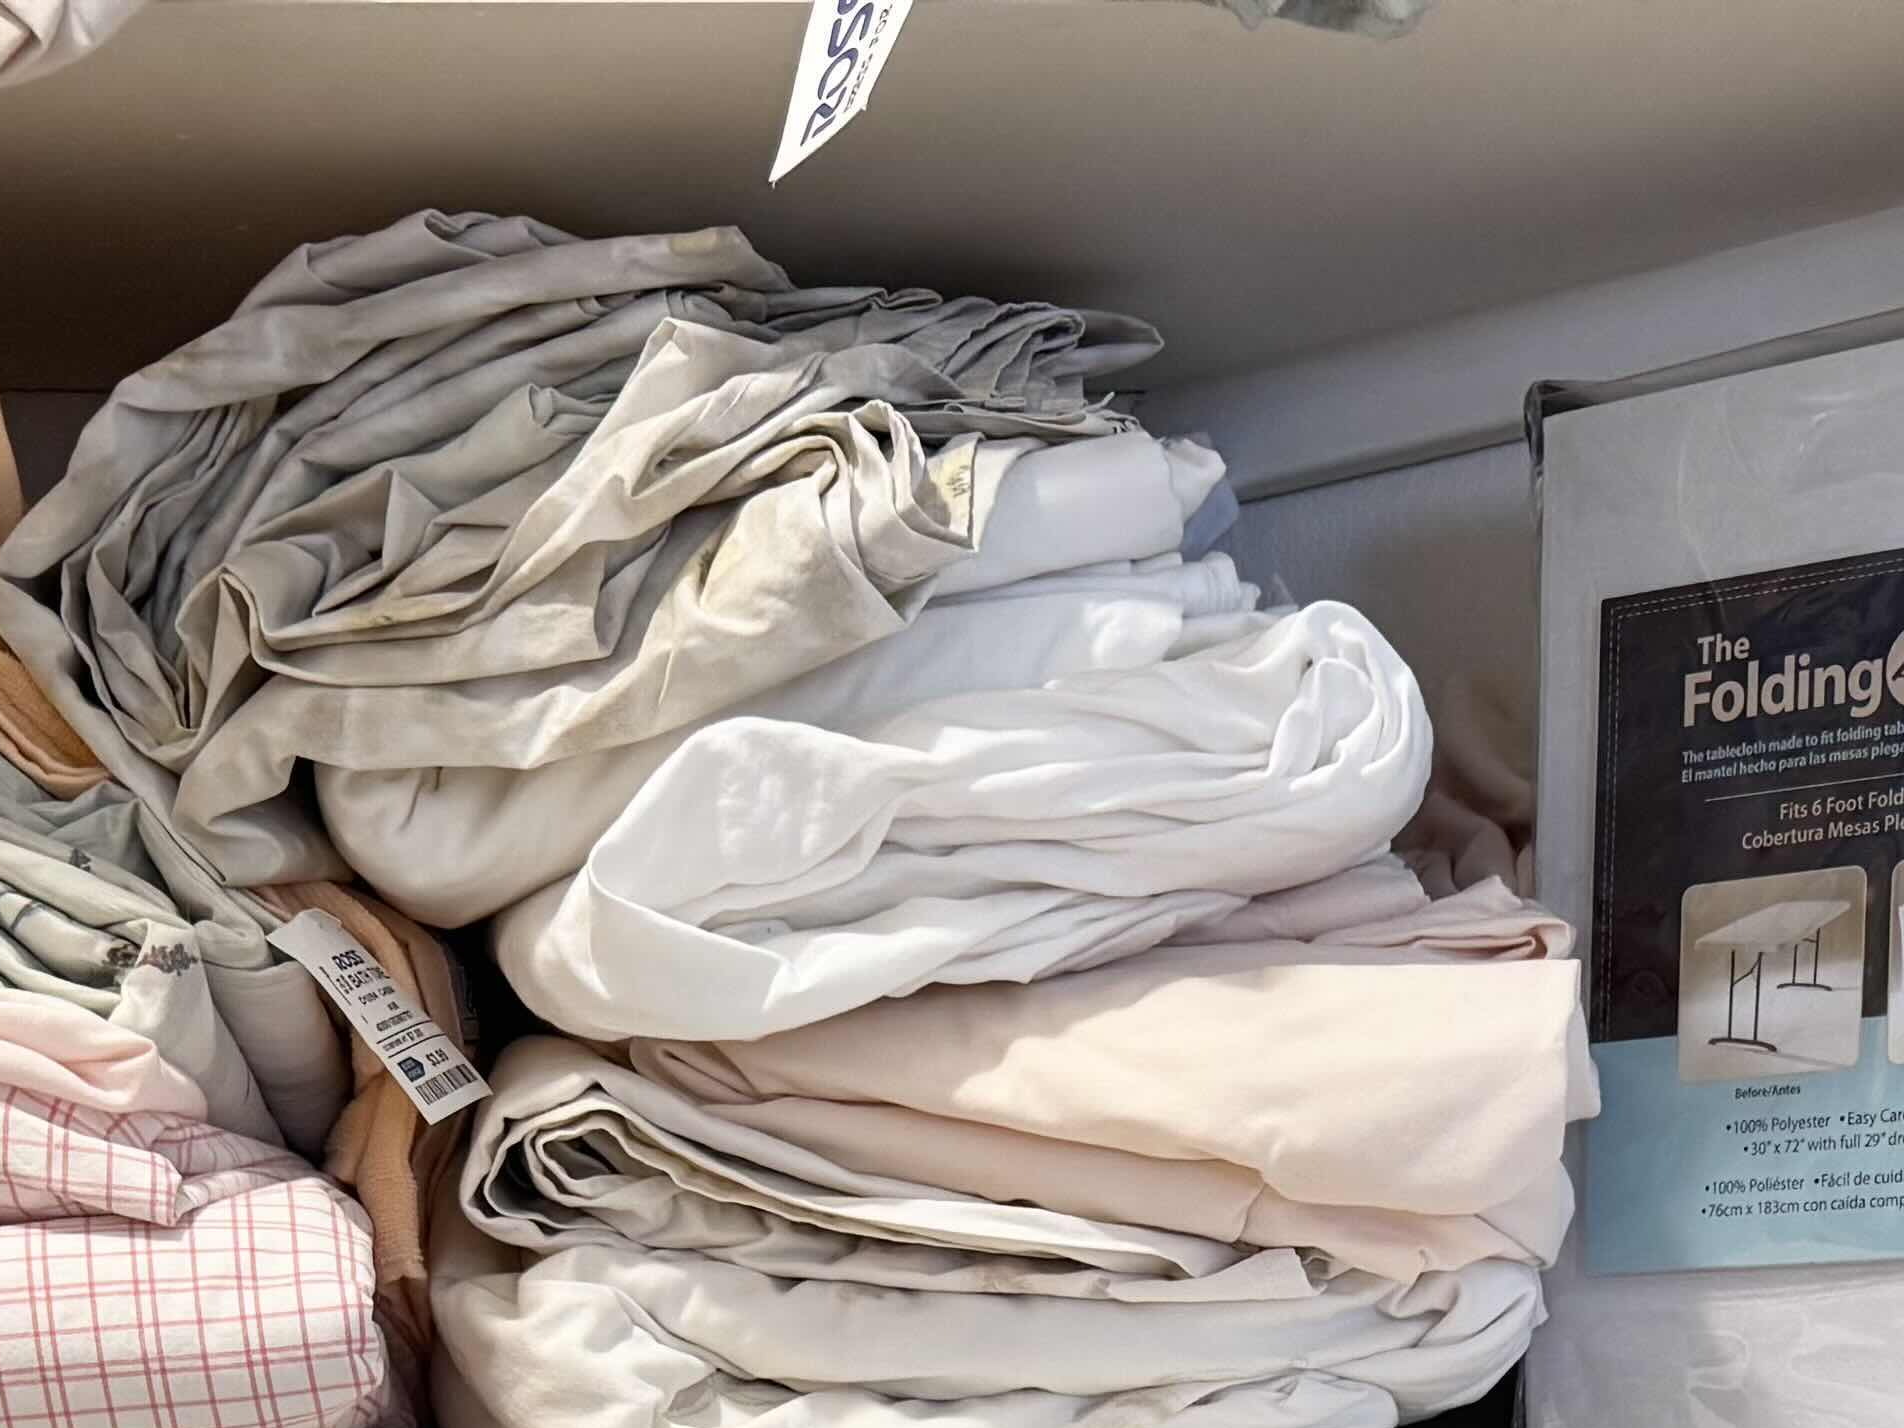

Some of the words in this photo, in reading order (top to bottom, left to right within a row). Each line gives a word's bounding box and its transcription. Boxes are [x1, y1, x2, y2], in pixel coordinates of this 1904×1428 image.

[1697, 633, 1750, 665] The
[1683, 653, 1883, 728] Folding
[1683, 750, 1704, 766] The
[1705, 741, 1767, 762] tablecloth
[1769, 736, 1802, 754] made
[1805, 734, 1818, 746] to
[1820, 730, 1834, 745] fit
[1836, 723, 1881, 745] folding
[1682, 769, 1693, 784] El
[1695, 761, 1737, 782] mantel
[1740, 758, 1776, 776] hecho
[1778, 755, 1806, 774] para
[1809, 750, 1826, 766] las
[1780, 800, 1808, 820] Fits
[1812, 799, 1821, 816] 6
[1826, 795, 1864, 815] Foot
[1742, 825, 1824, 850] Cobertura
[1828, 817, 1880, 839] Mesas
[332, 950, 365, 970] ROSS
[1771, 1115, 1831, 1134] Polyester
[1774, 1144, 1781, 1154] x
[1808, 1136, 1836, 1152] with
[1840, 1133, 1860, 1150] full
[1748, 1176, 1804, 1192] Poliéster
[1853, 1172, 1871, 1186] de
[1746, 1204, 1753, 1215] x
[1758, 1200, 1800, 1215] 183cm
[1803, 1200, 1827, 1212] con
[1830, 1194, 1866, 1210] caída
